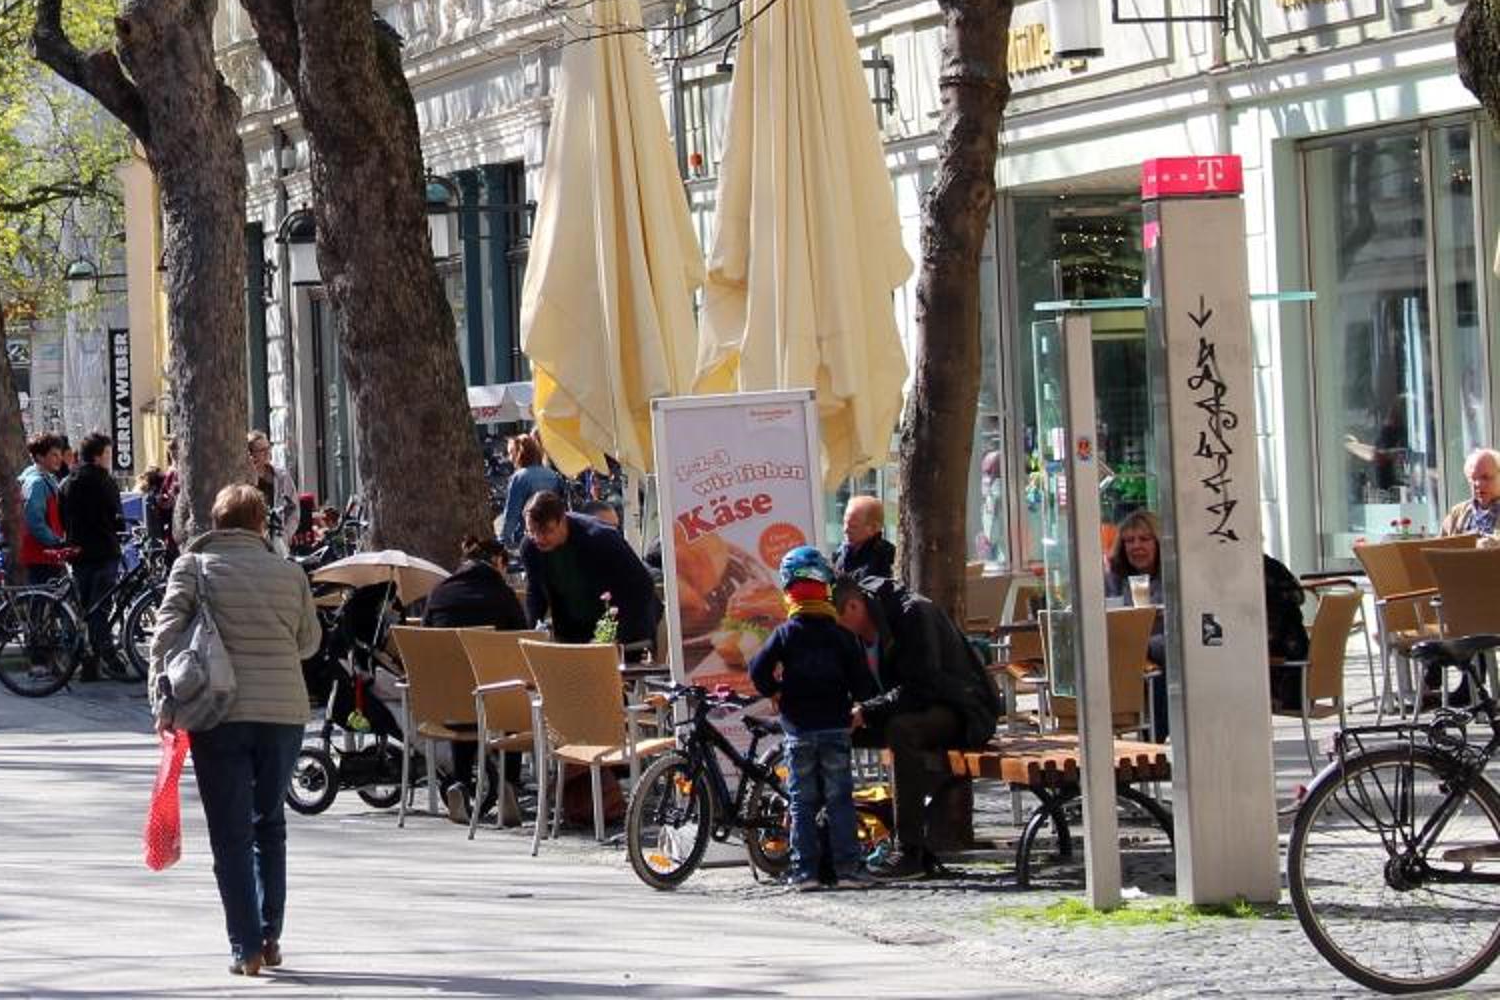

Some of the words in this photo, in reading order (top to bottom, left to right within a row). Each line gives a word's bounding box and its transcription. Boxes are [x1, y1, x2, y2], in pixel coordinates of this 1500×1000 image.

[1197, 159, 1223, 191] T
[113, 332, 131, 399] WEBER
[115, 402, 133, 469] GERRY
[692, 471, 734, 497] wir
[737, 460, 805, 484] lieben
[677, 493, 773, 542] Käse
